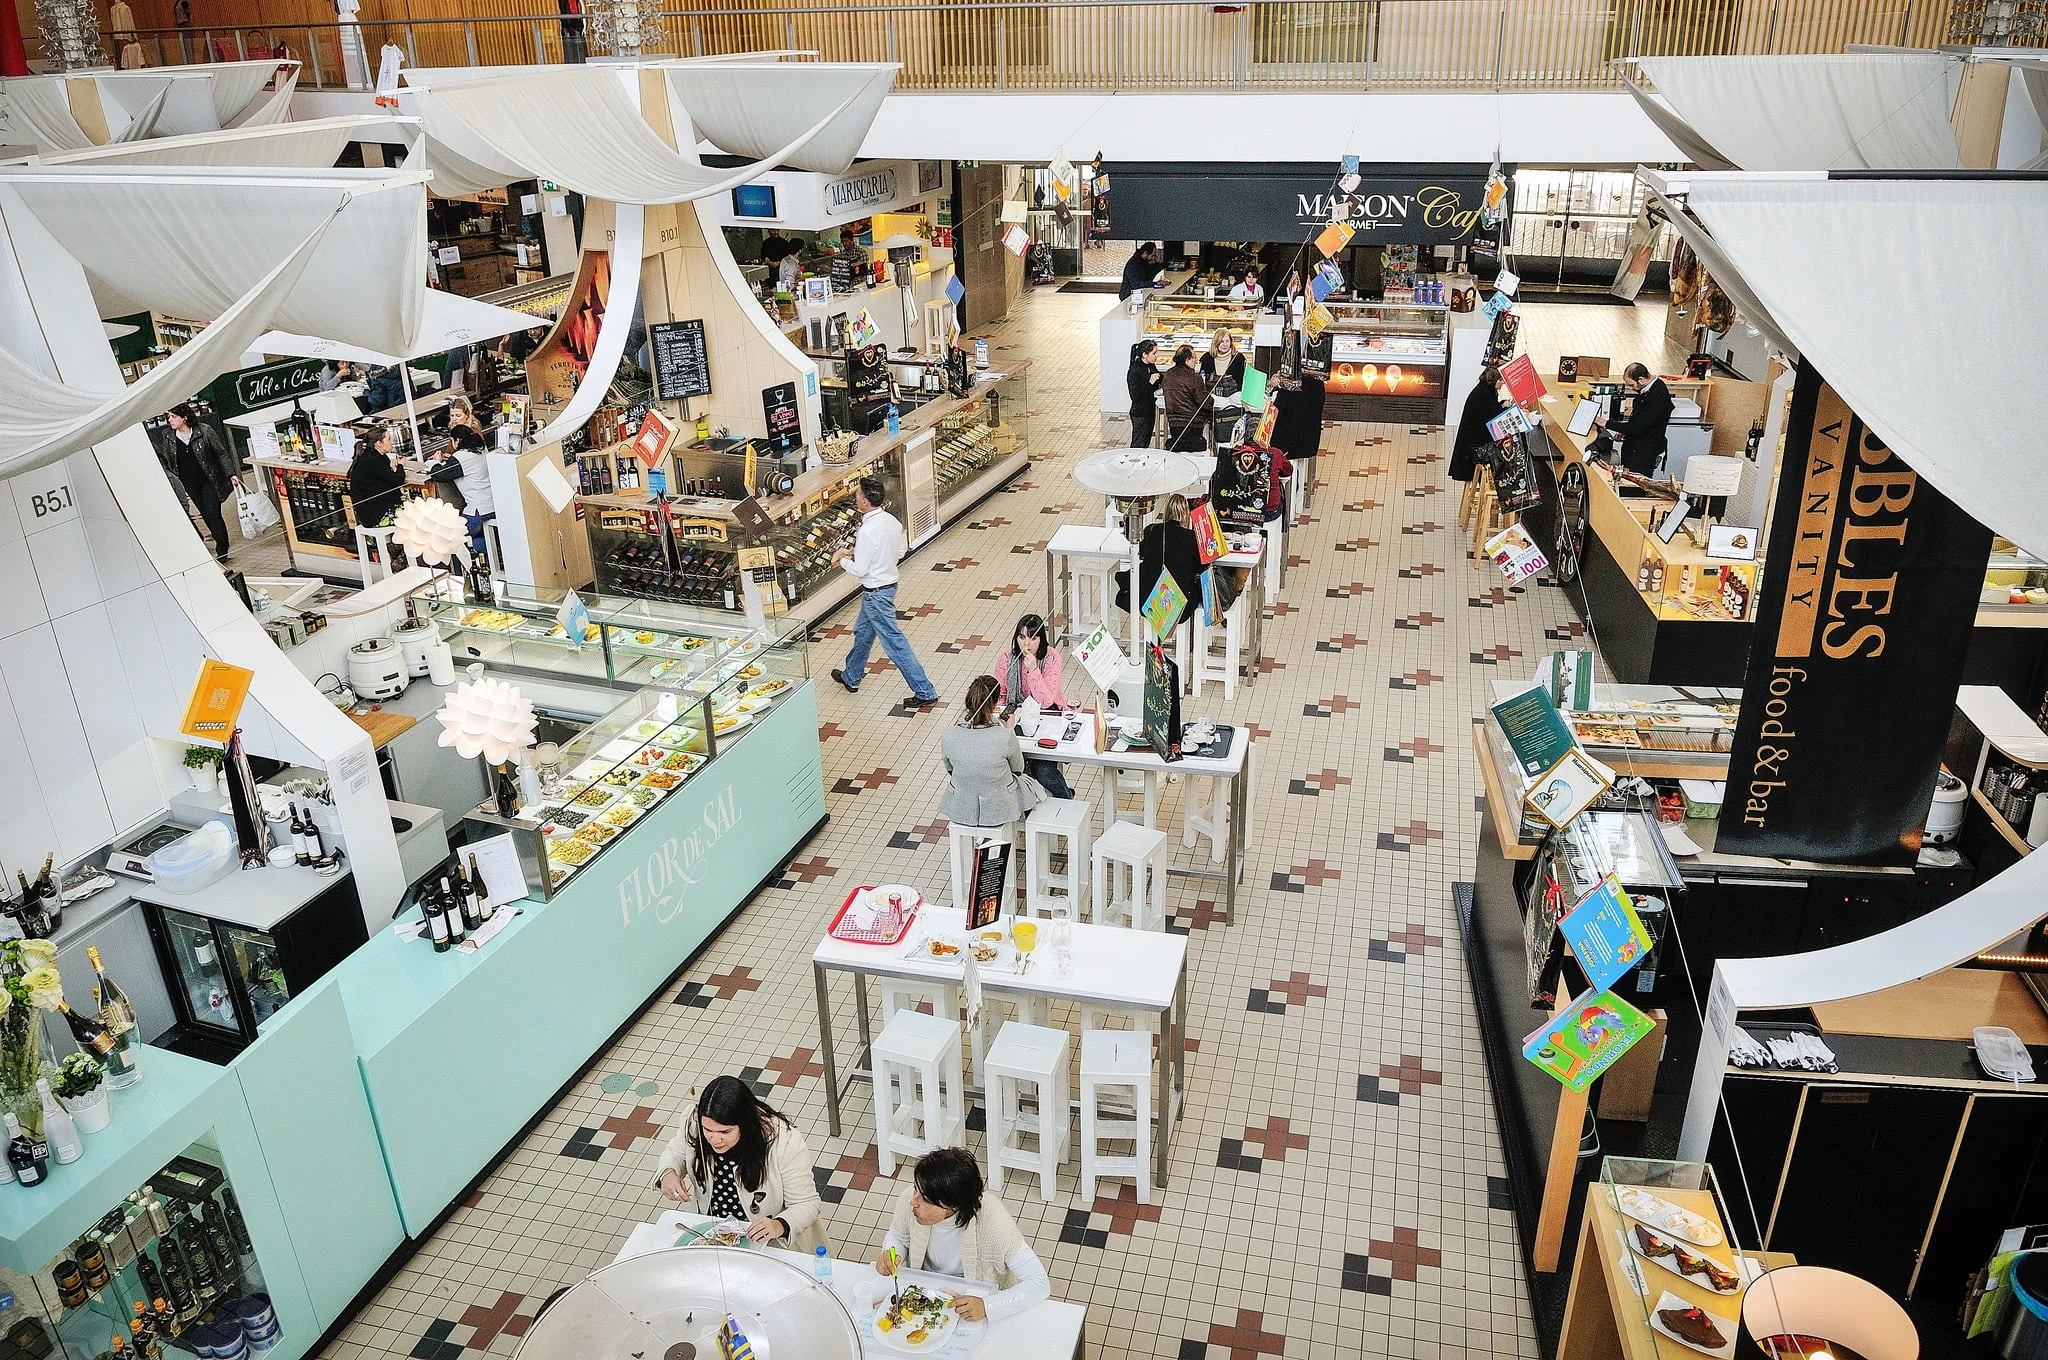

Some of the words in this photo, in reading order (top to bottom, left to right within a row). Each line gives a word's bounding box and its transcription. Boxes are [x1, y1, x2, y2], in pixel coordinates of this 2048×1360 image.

[832, 174, 889, 207] MARISCARIA
[660, 227, 679, 243] B10.1
[249, 375, 274, 401] Mil
[31, 485, 74, 519] B5.1
[1789, 418, 1844, 607] VANITY
[1519, 554, 1548, 577] 1001
[616, 837, 702, 929] FLOR
[681, 826, 705, 870] DE
[703, 783, 743, 849] SAL
[1584, 1032, 1633, 1077] FLORINDO
